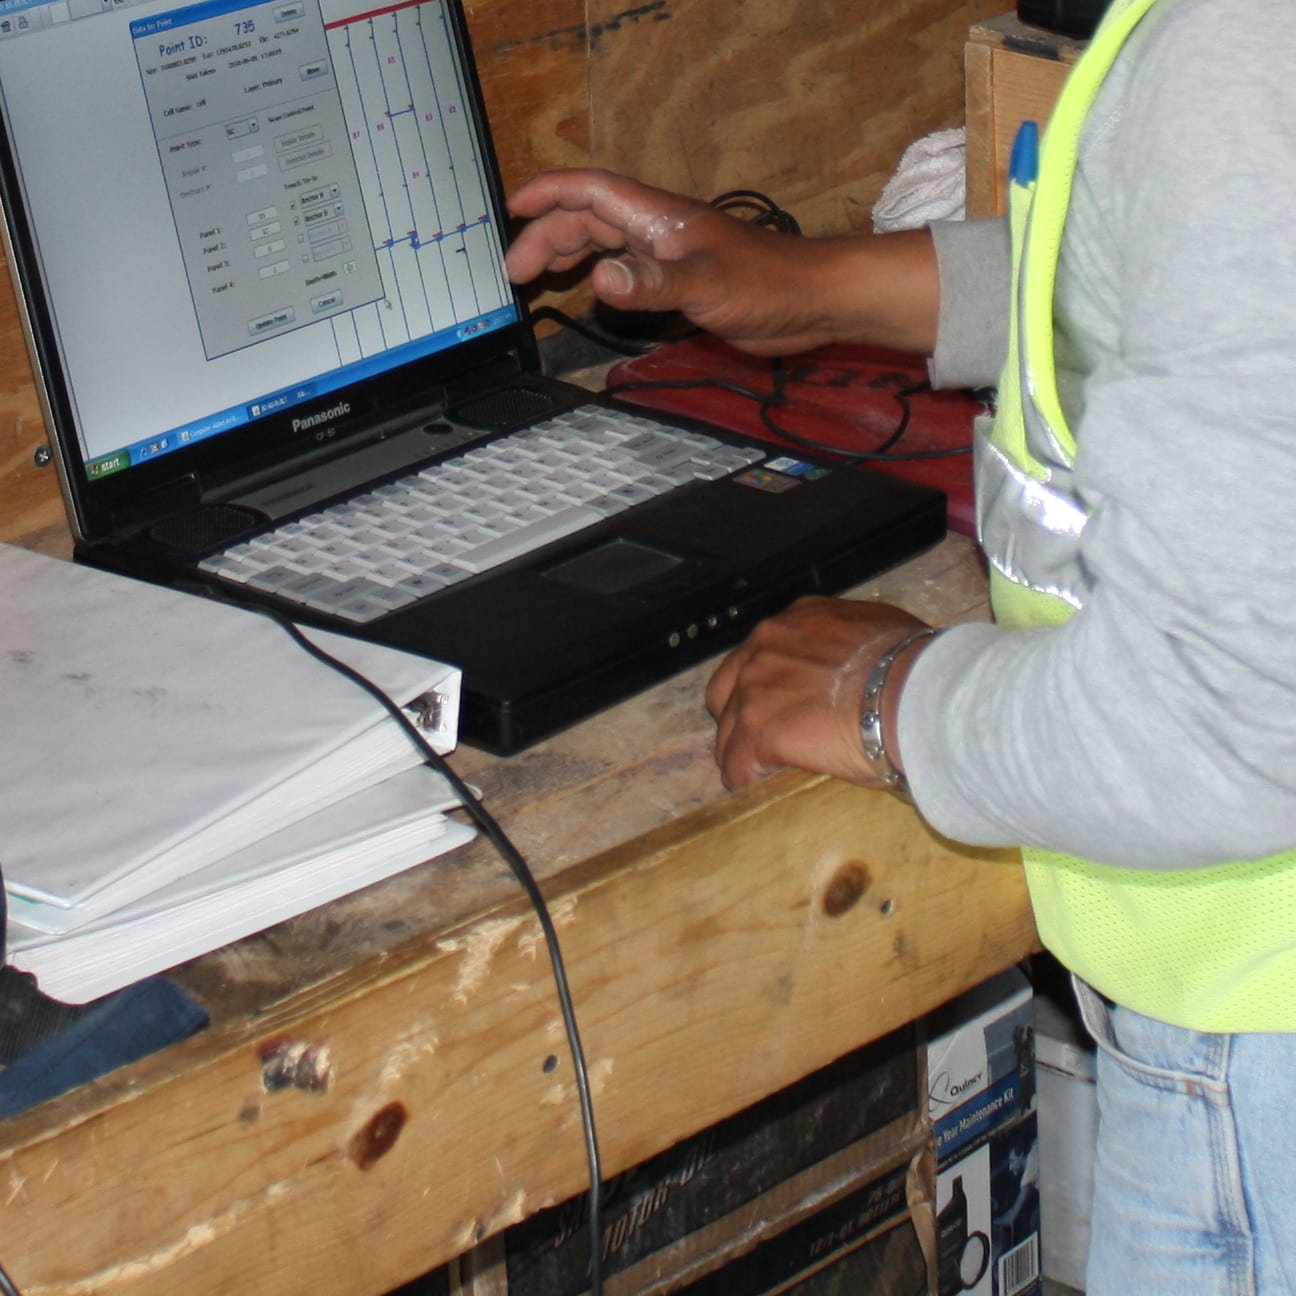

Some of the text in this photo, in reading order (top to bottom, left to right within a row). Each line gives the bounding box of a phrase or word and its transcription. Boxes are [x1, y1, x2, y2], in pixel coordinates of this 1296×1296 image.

[234, 20, 255, 36] 735
[159, 36, 208, 57] Point ID:
[291, 401, 351, 433] Panasonic
[101, 458, 120, 472] start
[943, 1087, 1015, 1145] Year Maintenance Kit
